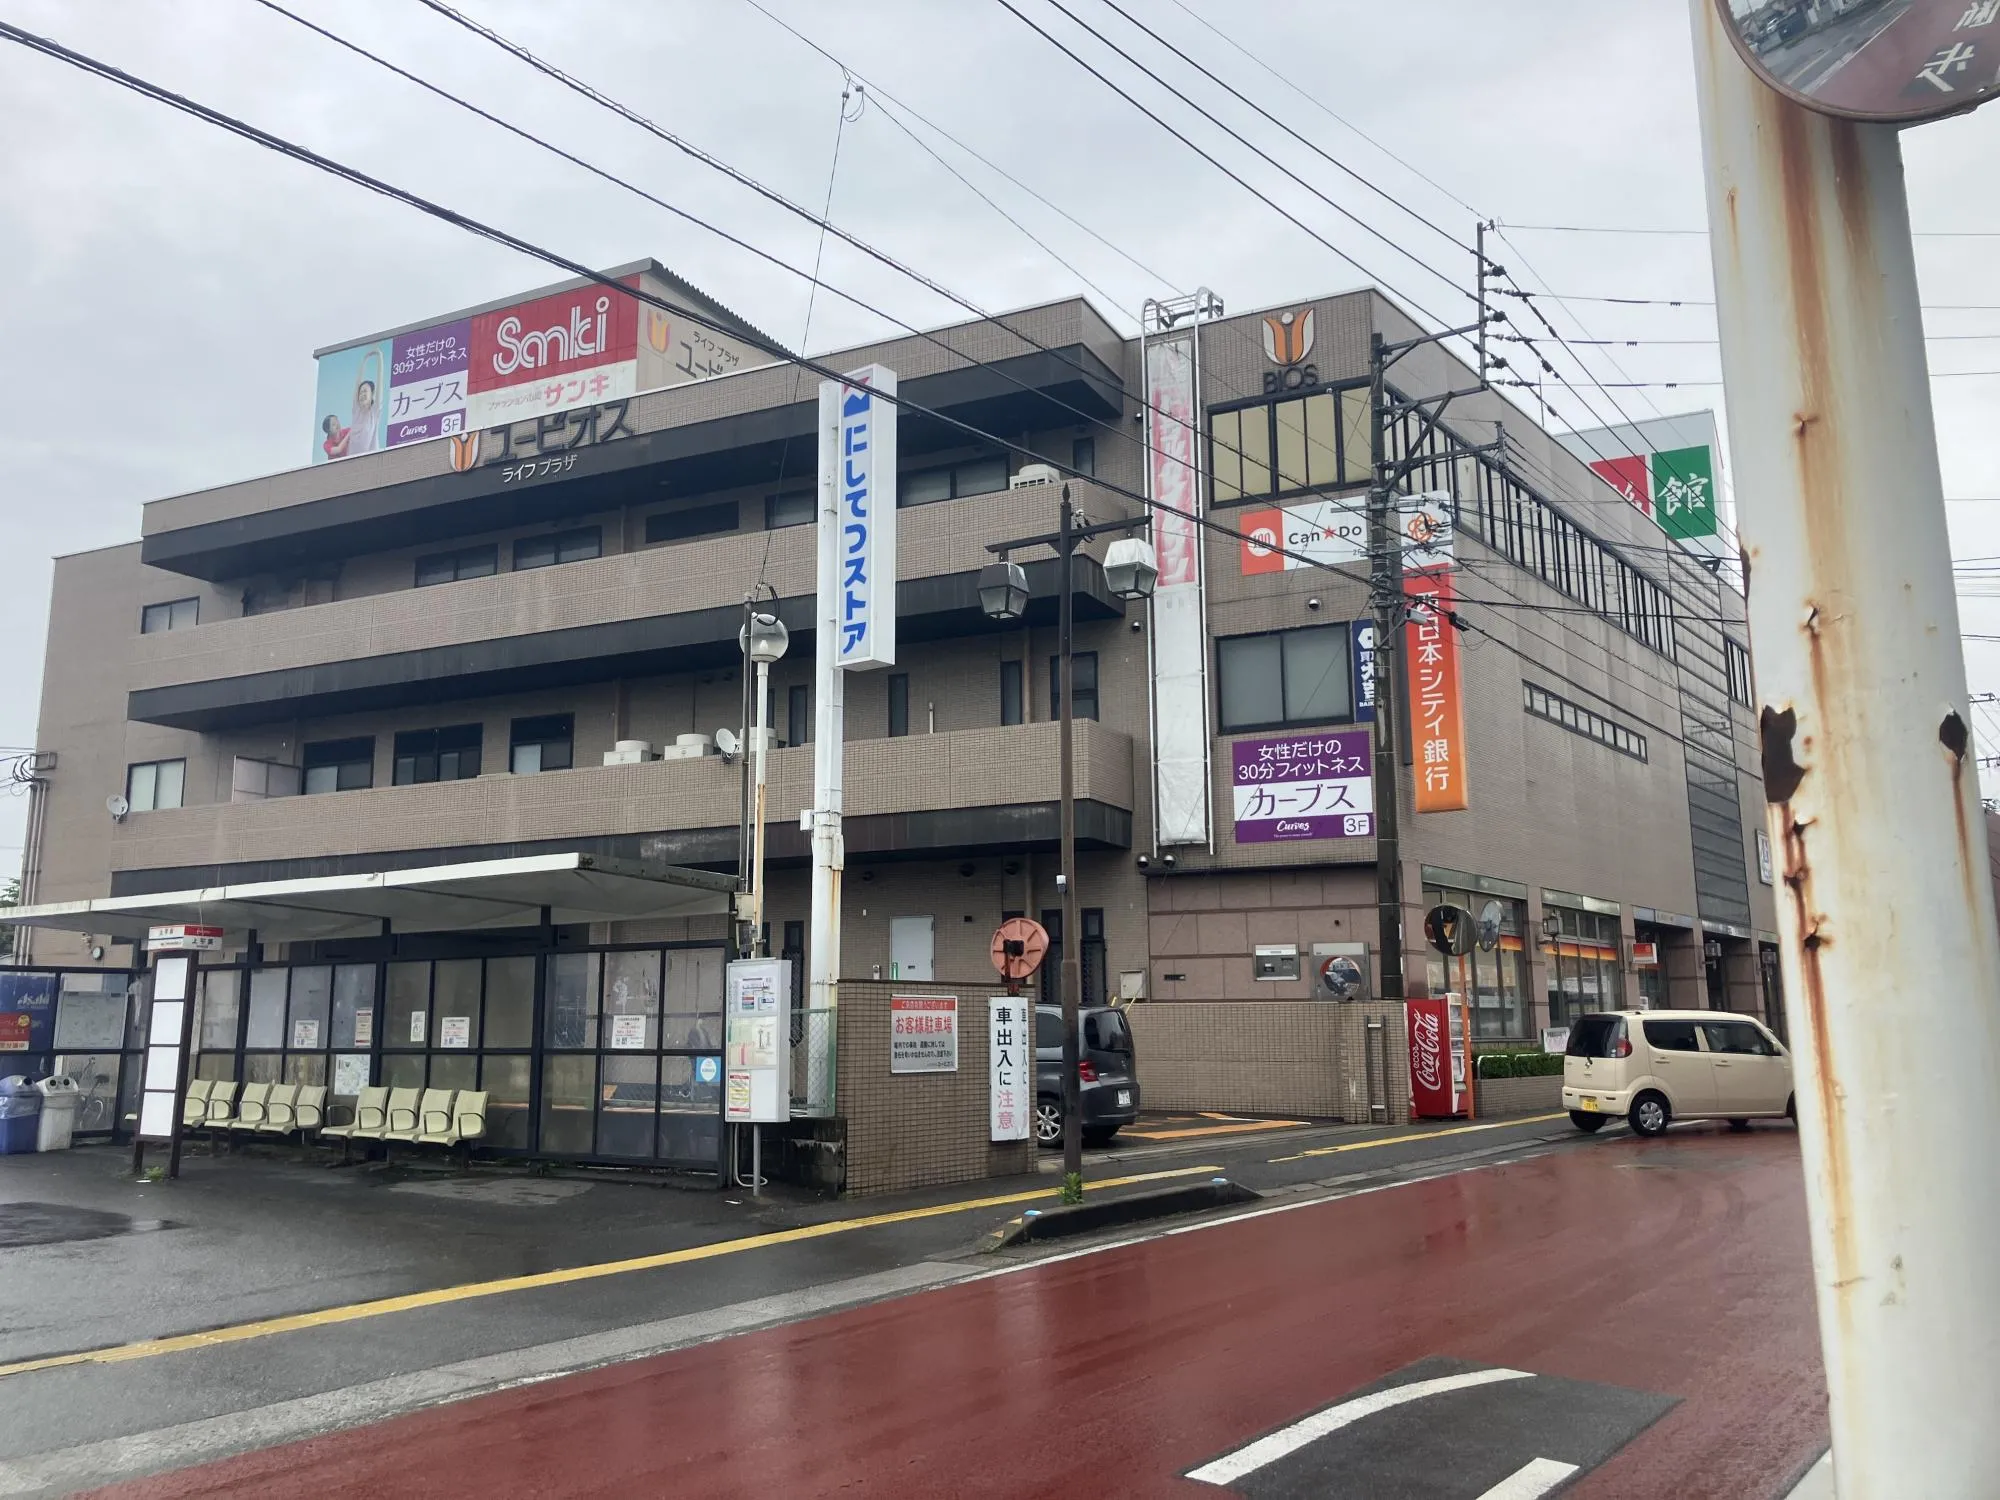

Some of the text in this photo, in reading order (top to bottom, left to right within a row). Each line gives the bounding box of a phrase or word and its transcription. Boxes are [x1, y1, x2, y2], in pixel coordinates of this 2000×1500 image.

[406, 336, 456, 360] 女性だけの
[493, 296, 610, 375] Sanki
[392, 347, 468, 375] 30分フィットネス
[543, 373, 610, 407] サンキ
[1263, 364, 1317, 394] BIOS
[391, 381, 463, 417] カーブス
[400, 424, 428, 438] Curves
[442, 417, 460, 433] 3F
[1656, 472, 1709, 516] 館
[843, 424, 867, 654] にしてつストア
[1288, 525, 1363, 546] Can Do
[1415, 589, 1450, 792] 西日本シティ銀行
[1258, 739, 1342, 762] 女性だけの
[1238, 756, 1365, 780] 30分フィットネス
[1249, 784, 1356, 817] カーブス
[1276, 820, 1310, 832] Curves
[1345, 817, 1368, 833] 3F
[895, 1015, 953, 1034] お客様駐車場
[1414, 1008, 1441, 1090] Coca-Cola
[995, 1006, 1014, 1130] 車出入に注意
